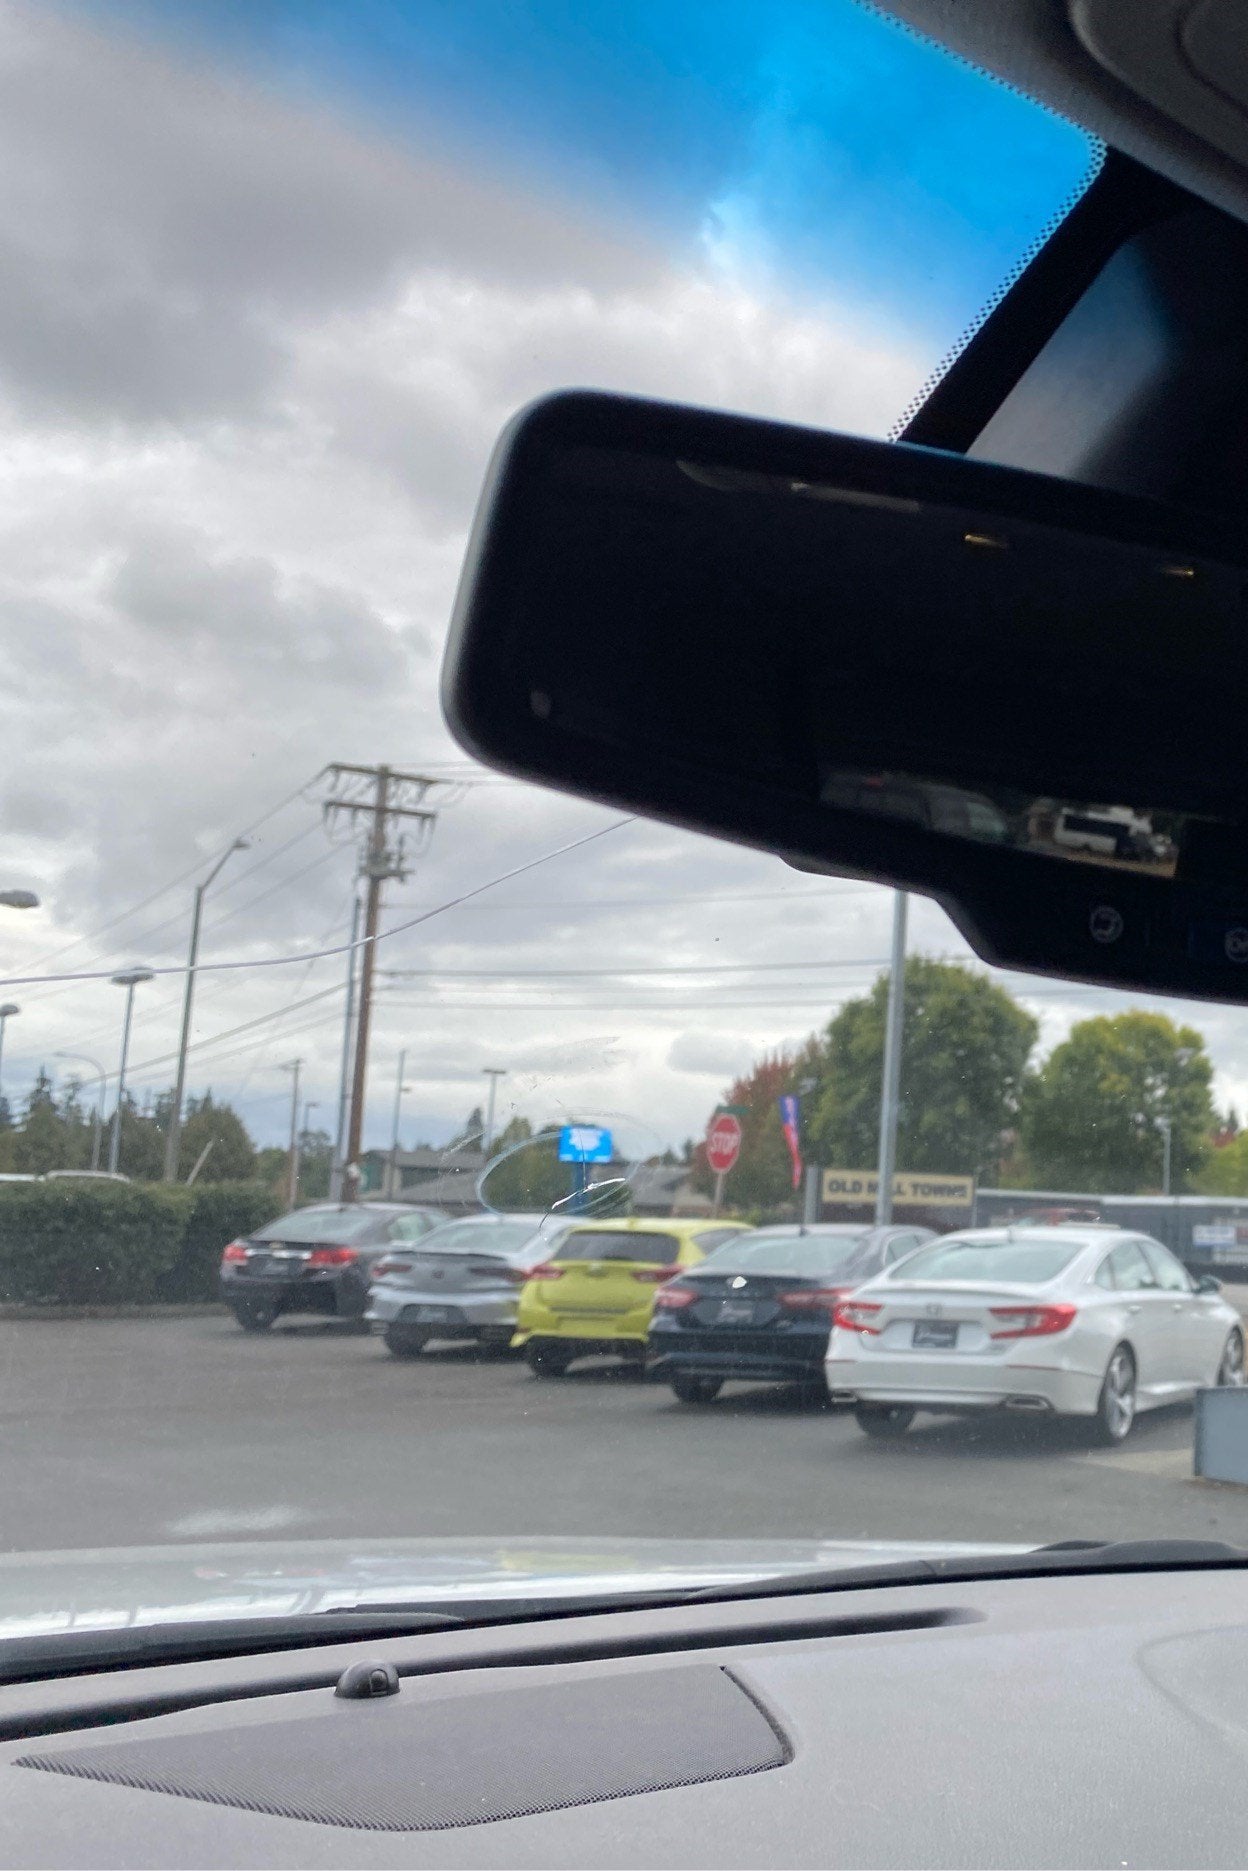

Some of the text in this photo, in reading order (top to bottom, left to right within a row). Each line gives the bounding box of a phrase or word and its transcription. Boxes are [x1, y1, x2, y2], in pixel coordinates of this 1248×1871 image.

[711, 1131, 738, 1155] STOP
[829, 1180, 862, 1195] OLD
[867, 1181, 906, 1196] ML
